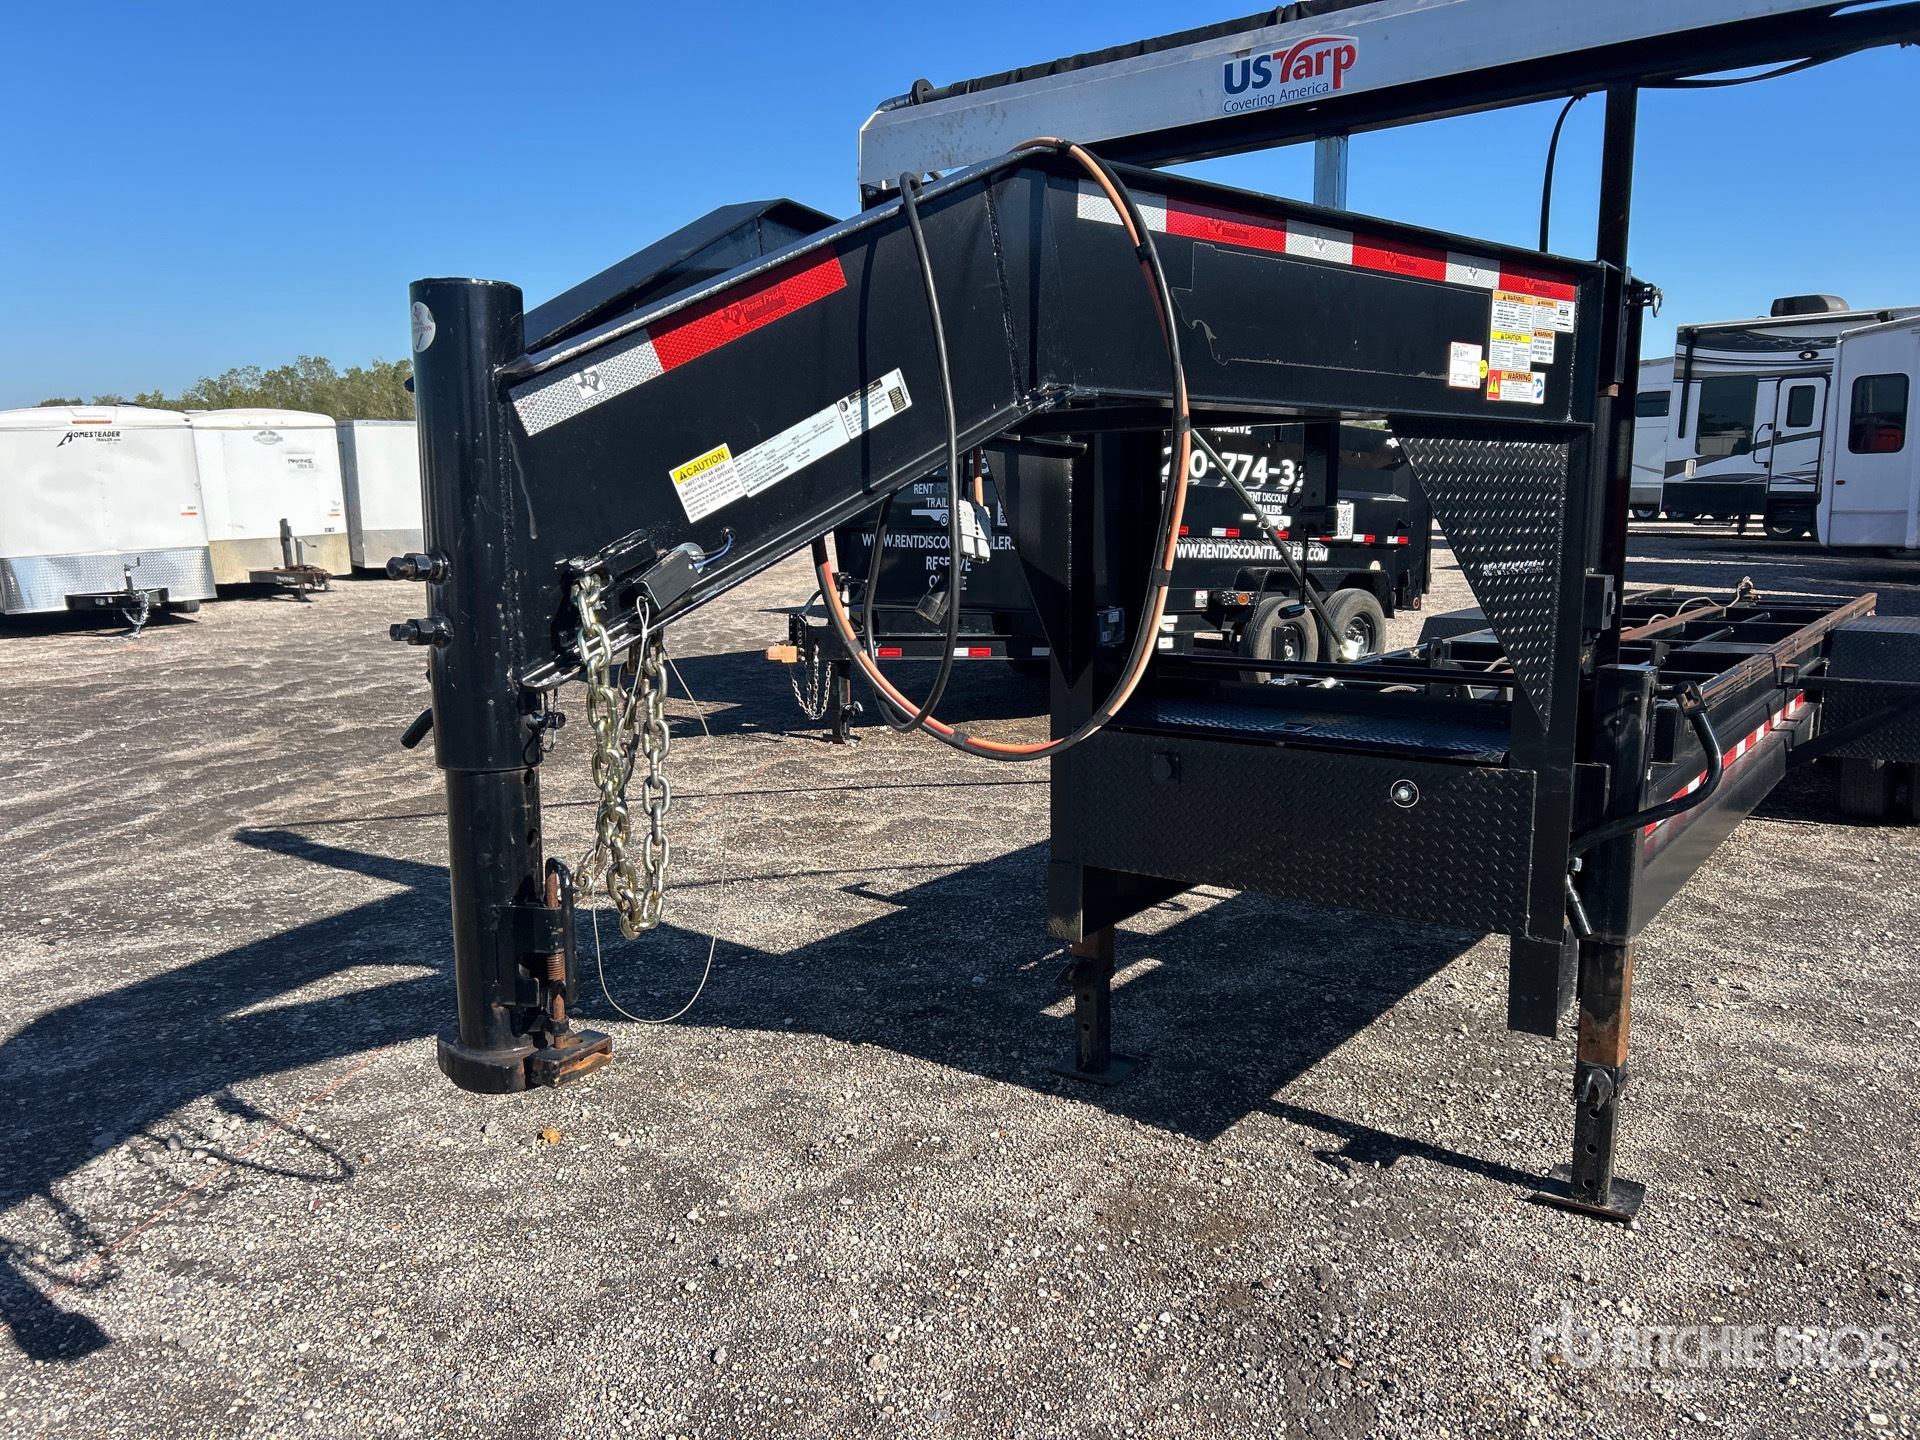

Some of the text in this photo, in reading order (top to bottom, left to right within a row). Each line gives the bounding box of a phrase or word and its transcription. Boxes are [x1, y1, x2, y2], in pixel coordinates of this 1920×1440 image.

[1224, 82, 1329, 113] Covering America
[742, 299, 763, 314] Texas
[763, 288, 784, 305] Pride
[584, 374, 597, 386] TP
[1507, 373, 1532, 382] WARNING
[685, 451, 726, 476] CAUTION
[683, 476, 700, 488] SAFETY
[680, 485, 698, 497] SWITCH
[913, 483, 934, 495] RENT
[926, 498, 949, 508] TRAIL
[1262, 492, 1288, 504] DISCOUN
